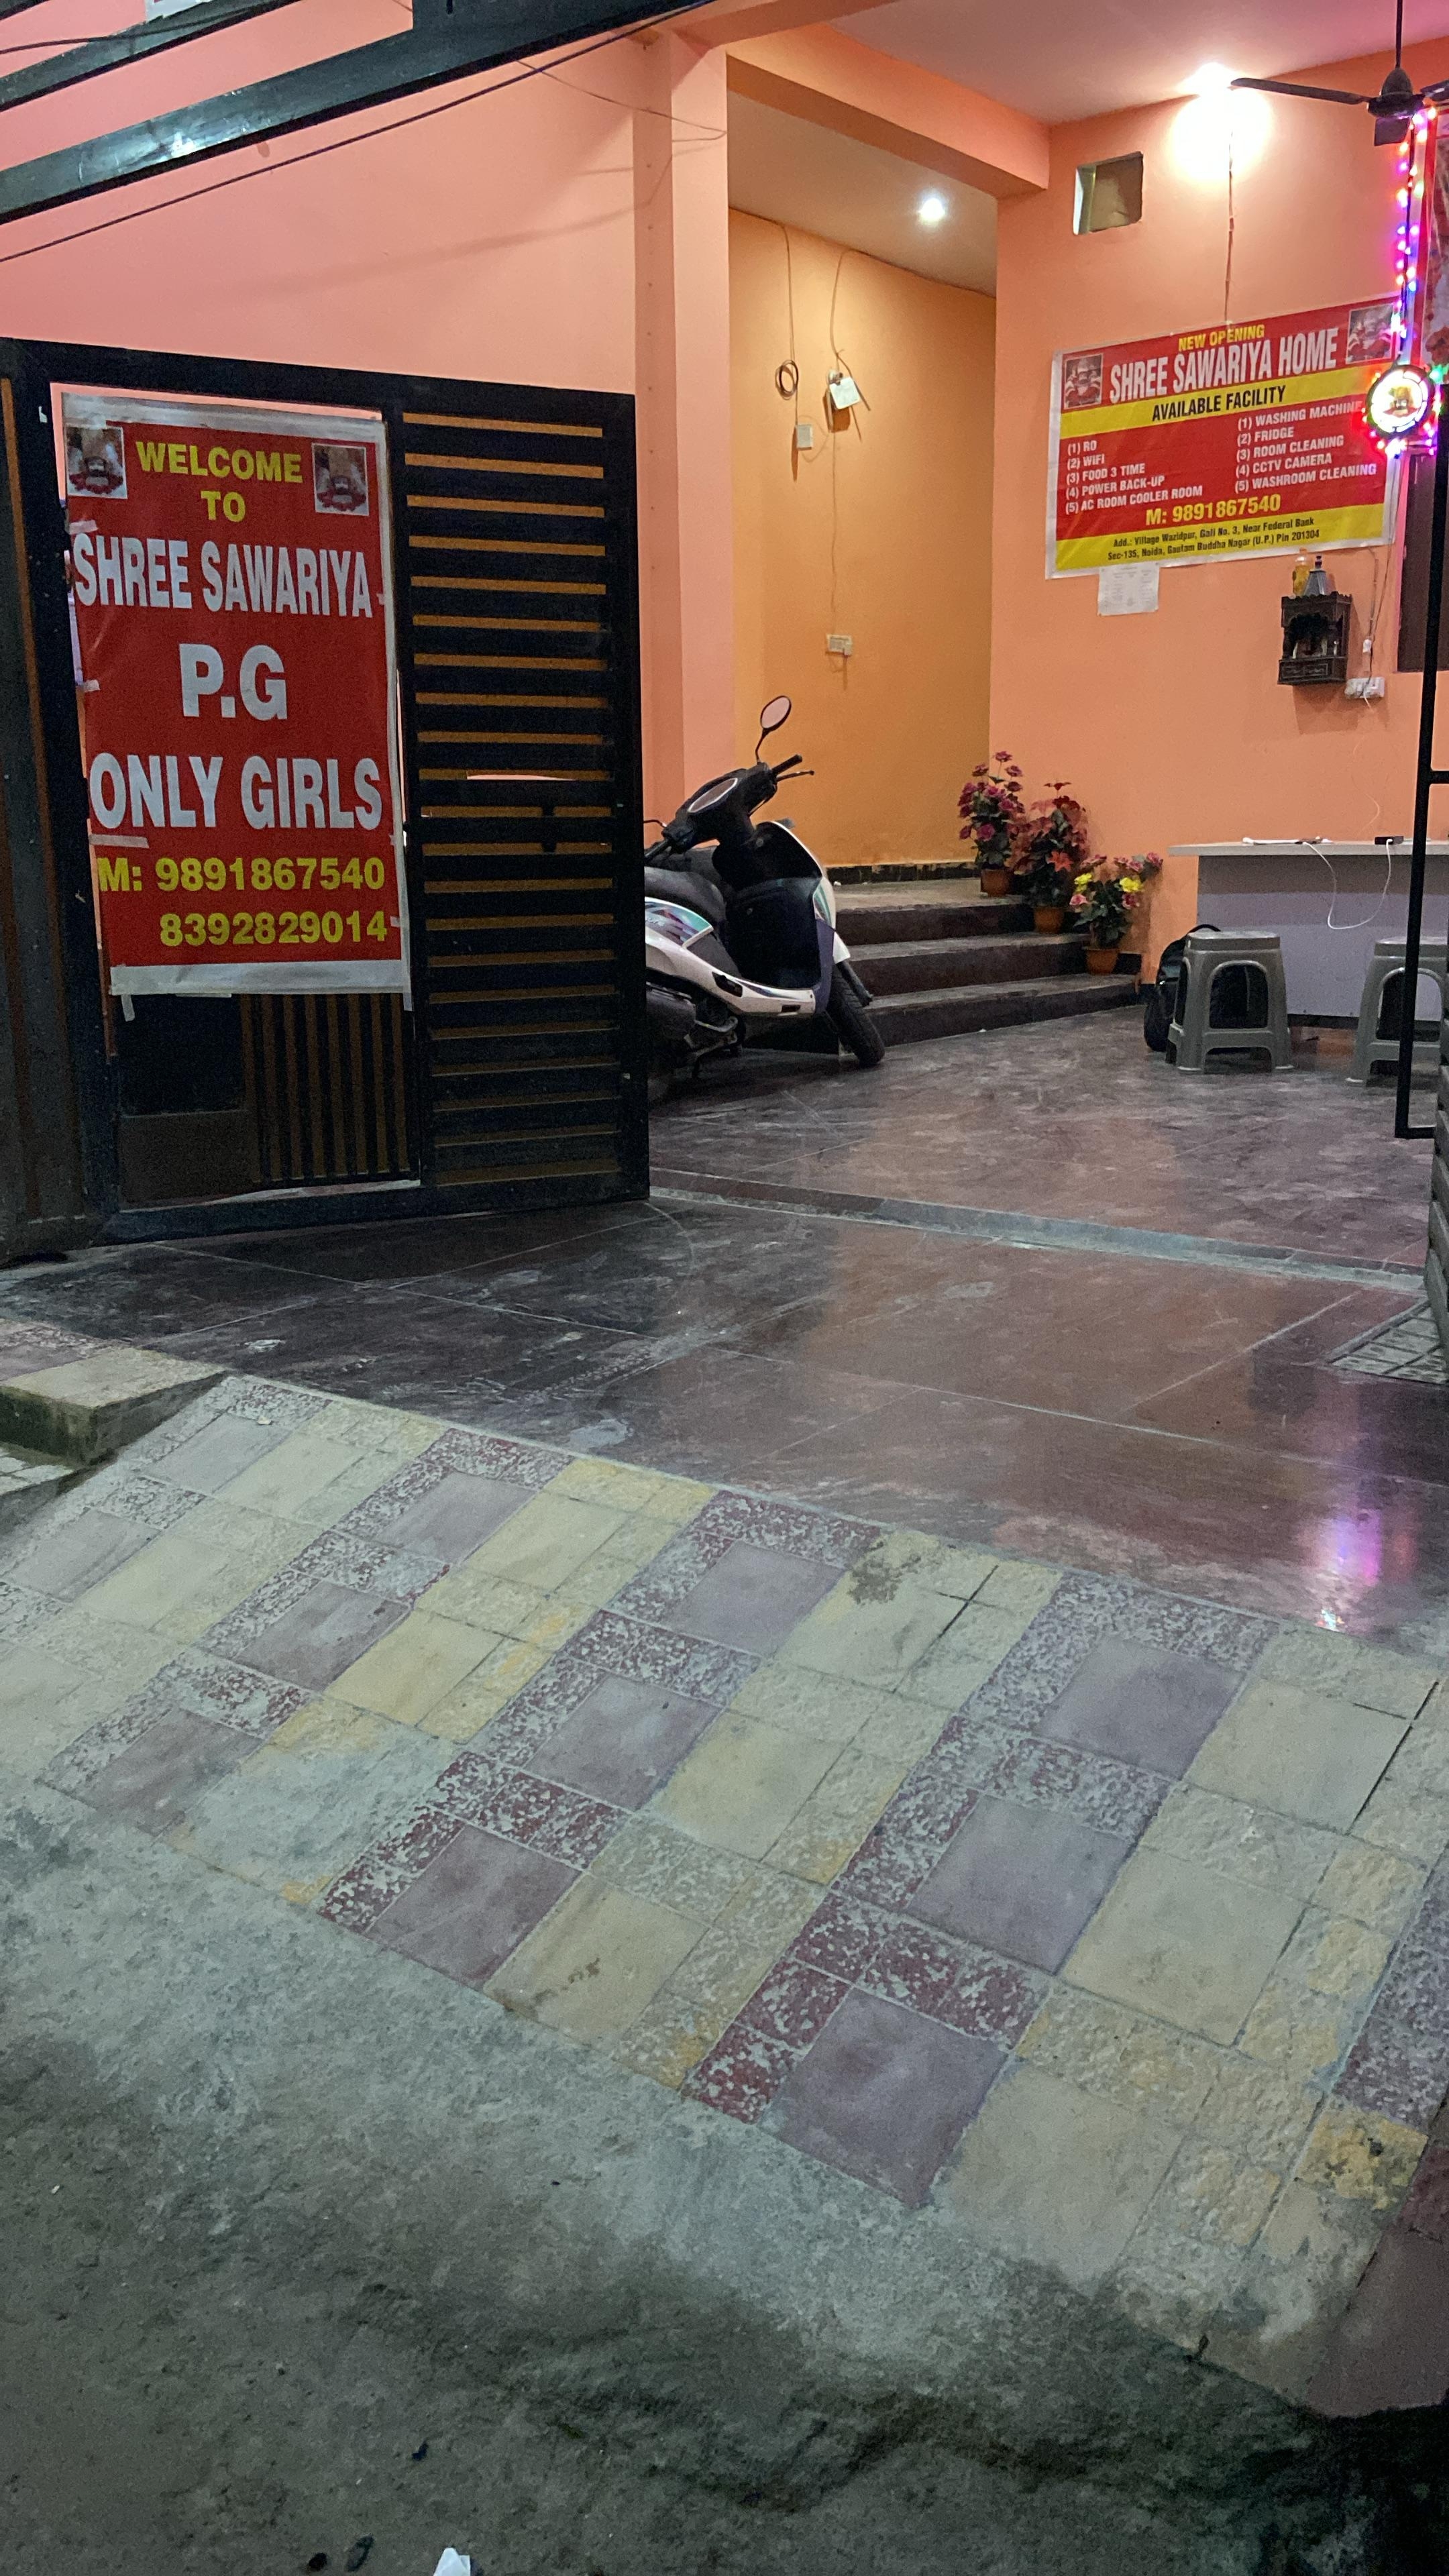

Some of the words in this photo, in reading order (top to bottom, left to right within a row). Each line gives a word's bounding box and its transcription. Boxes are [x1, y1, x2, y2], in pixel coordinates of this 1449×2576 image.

[1179, 335, 1205, 351] NEW
[1210, 325, 1265, 346] OPENING
[1110, 356, 1168, 404] SHREE
[1173, 339, 1272, 393] SAWARIYA
[1278, 328, 1339, 376] HOME
[1152, 395, 1221, 421] AVAILABLE
[1226, 385, 1286, 409] FACILITY
[1238, 417, 1252, 431] (1)
[1255, 409, 1305, 427] WASHING
[1067, 442, 1081, 455] (1)
[1083, 440, 1097, 451] RO
[1236, 449, 1250, 463] (3)
[1253, 444, 1286, 458] ROOM
[1289, 435, 1344, 453] CLEANING
[1237, 433, 1251, 447] (2)
[1254, 427, 1294, 442] FRIDGE
[136, 441, 303, 483] WELCOME
[1066, 472, 1079, 485] (3)
[1082, 468, 1108, 482] FOOD
[1110, 467, 1117, 477] 3
[1120, 463, 1145, 476] TIME
[1067, 458, 1080, 470] (2)
[1083, 453, 1105, 466] WIFI
[1236, 465, 1250, 478] (4)
[1252, 460, 1282, 474] CCTV
[1285, 453, 1332, 470] CAMERA
[1066, 486, 1079, 500] (4)
[1081, 482, 1117, 496] POWER
[1120, 475, 1165, 491] BACK-UP
[1235, 480, 1249, 494] (5)
[1252, 471, 1316, 490] WASHROOM
[1319, 464, 1377, 482] CLEANING
[201, 490, 246, 522] TO
[1065, 502, 1079, 515] (5)
[1081, 500, 1094, 511] AC
[1097, 495, 1127, 508] ROOM
[1130, 490, 1169, 505] COOLER
[1171, 486, 1203, 498] ROOM
[1146, 508, 1167, 525] M:
[1173, 494, 1281, 522] 9891867540
[1134, 535, 1159, 545] Village
[1243, 523, 1260, 533] Near
[1263, 519, 1293, 530] Federal
[1295, 517, 1314, 527] Bank
[1167, 544, 1195, 554] Gautam
[1197, 540, 1226, 550] Buddha
[1228, 537, 1250, 549] Nagar
[1276, 532, 1289, 542] Pin
[1291, 529, 1320, 541] 201304
[72, 533, 192, 609] SHREE
[201, 541, 372, 617] SAWARIYA
[179, 643, 287, 720] P.G
[89, 753, 223, 829] ONLY
[241, 755, 382, 830] GIRLS
[97, 857, 142, 892] M:
[155, 857, 385, 891] 9891867540
[160, 912, 387, 947] 8392829014
